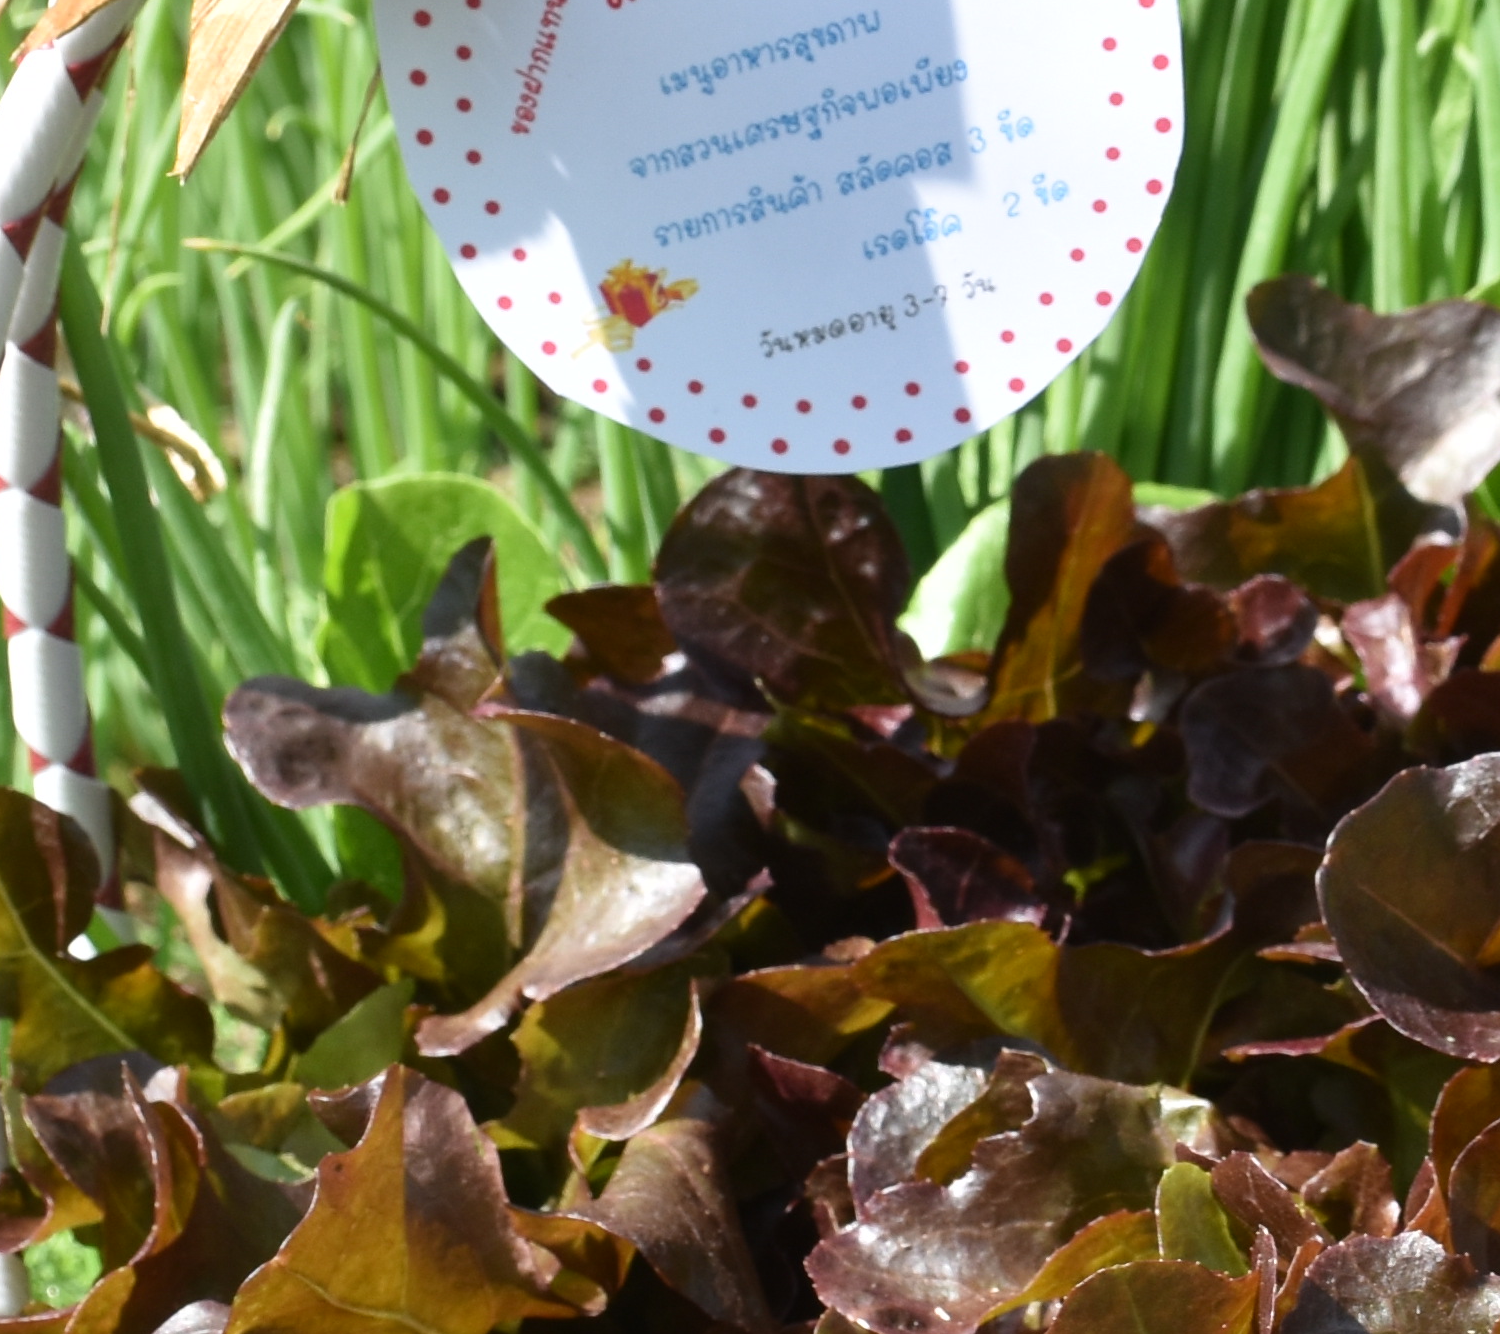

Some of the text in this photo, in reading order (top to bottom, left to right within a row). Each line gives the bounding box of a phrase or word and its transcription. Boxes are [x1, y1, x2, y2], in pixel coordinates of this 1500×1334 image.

[658, 9, 882, 96] เมนูอาหารสุขภาพ
[629, 56, 968, 178] จากสวนเศรษฐกิจพอเพียง
[652, 174, 823, 247] รายการสินค้า
[968, 125, 987, 154] 3
[1002, 191, 1022, 218] 2
[759, 304, 897, 359] วันหมดอายุ
[961, 270, 998, 299] วัน
